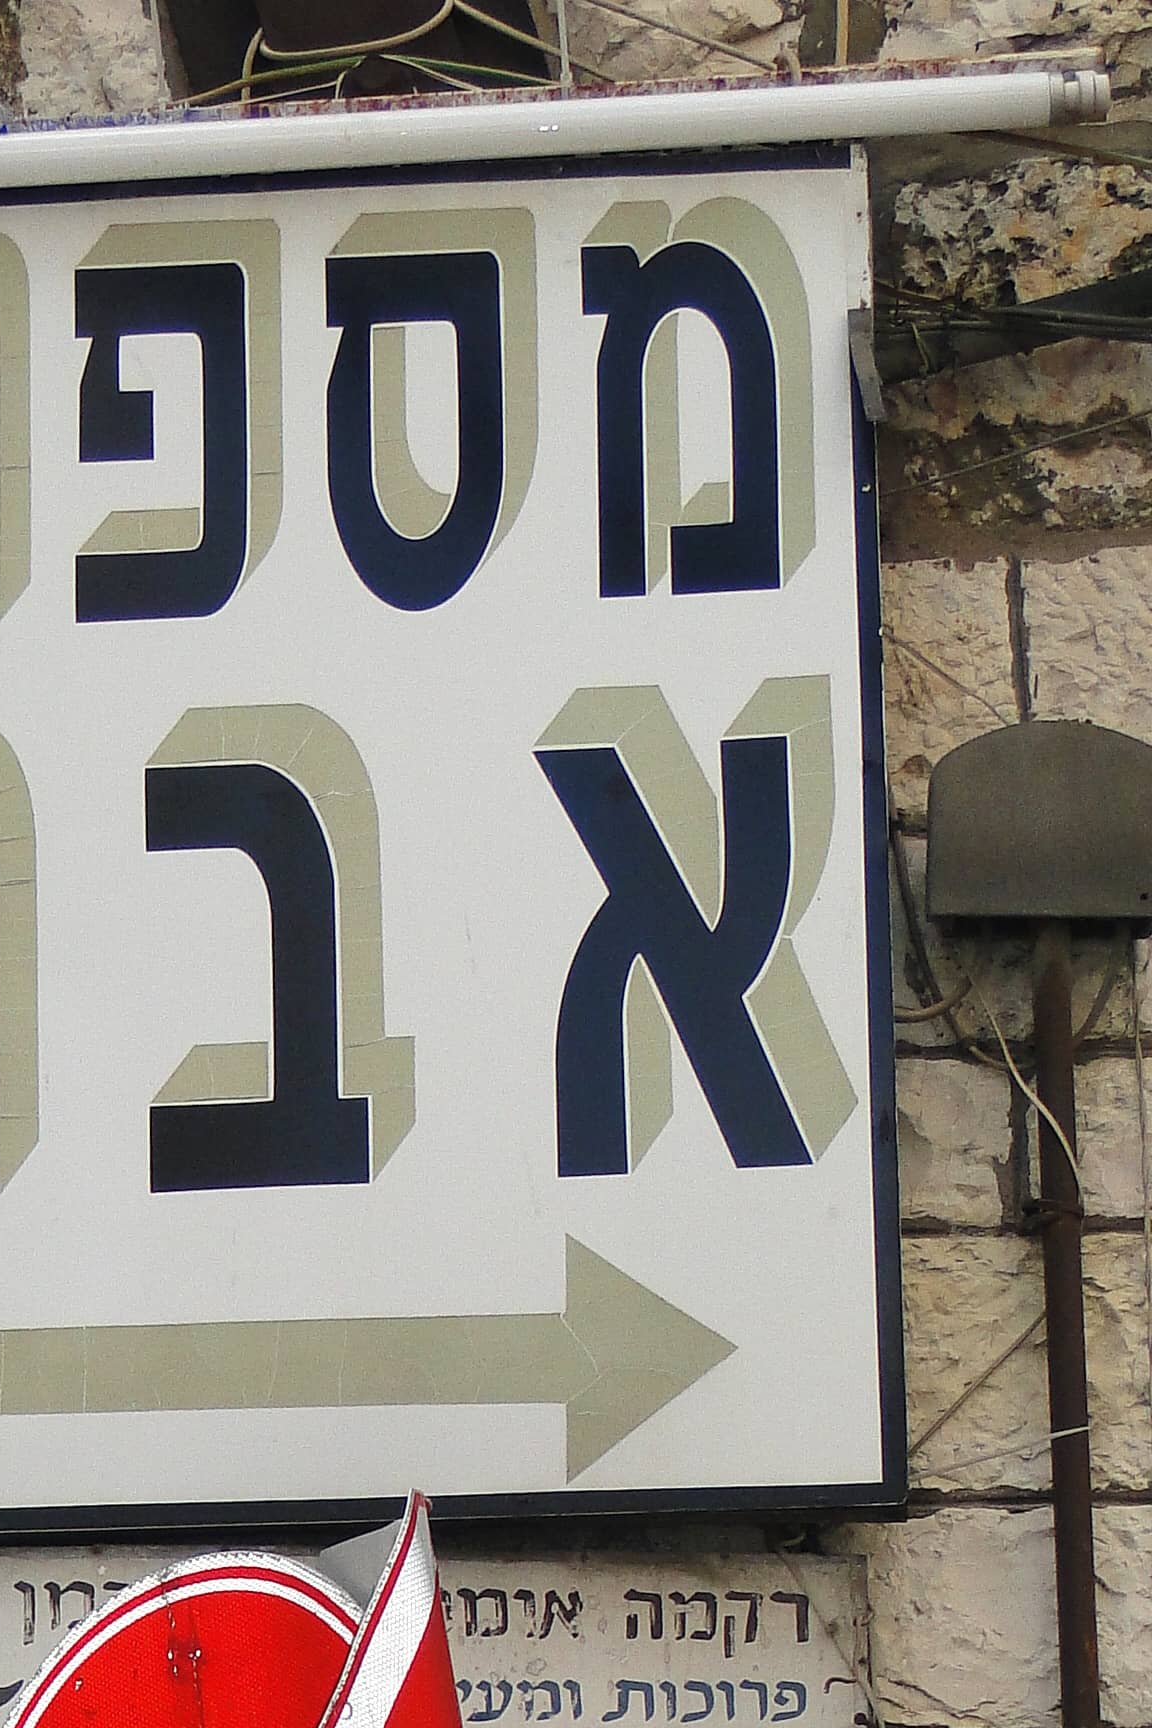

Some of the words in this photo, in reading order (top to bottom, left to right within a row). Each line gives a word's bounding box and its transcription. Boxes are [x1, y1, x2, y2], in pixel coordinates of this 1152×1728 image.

[625, 1589, 811, 1658] רקמה
[456, 1679, 583, 1722] ומעי
[602, 1678, 809, 1723] פרוכות
